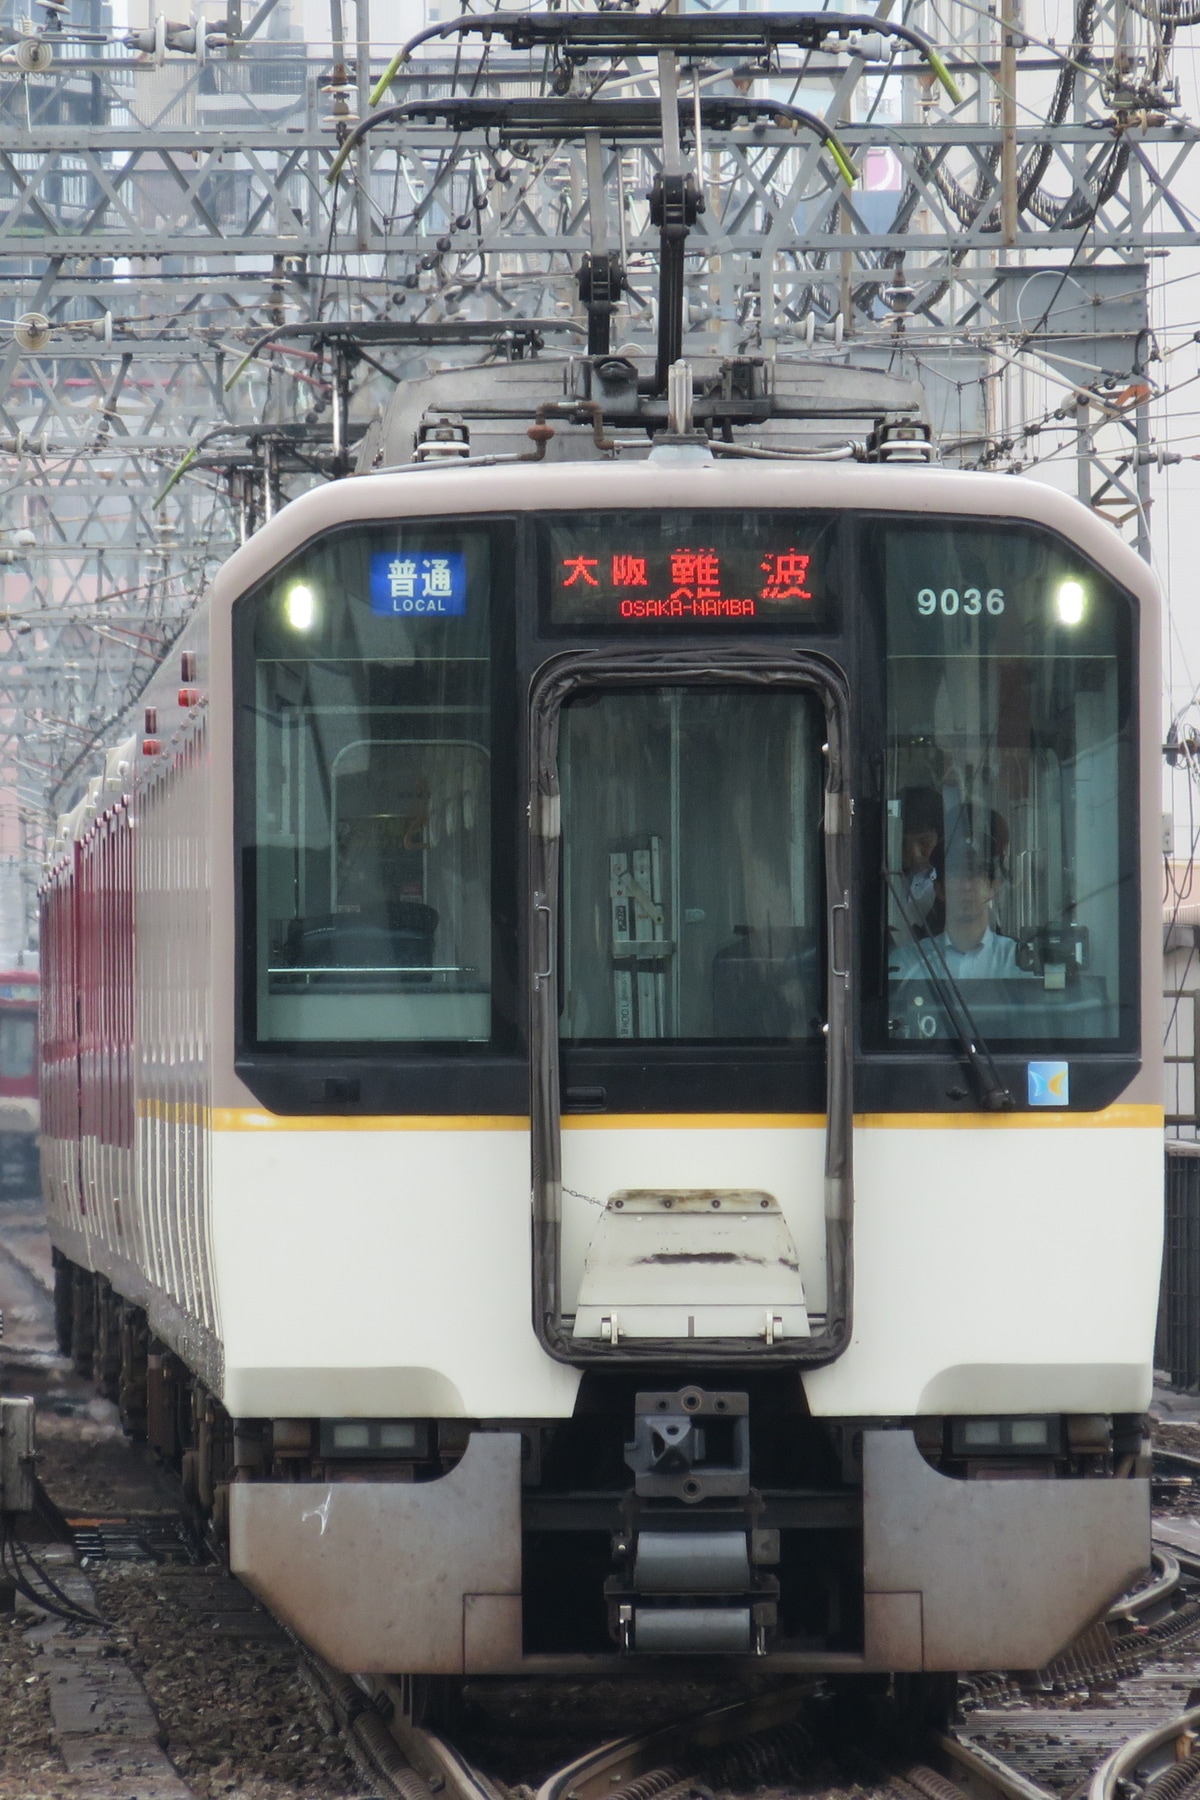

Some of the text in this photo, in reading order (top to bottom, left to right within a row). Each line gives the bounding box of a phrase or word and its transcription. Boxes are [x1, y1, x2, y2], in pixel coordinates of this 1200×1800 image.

[387, 559, 452, 598] 普通
[563, 548, 812, 599] 大阪難波
[393, 599, 446, 612] LOCAL
[620, 599, 755, 617] OSAKA-NAMBA
[917, 588, 1005, 616] 9036
